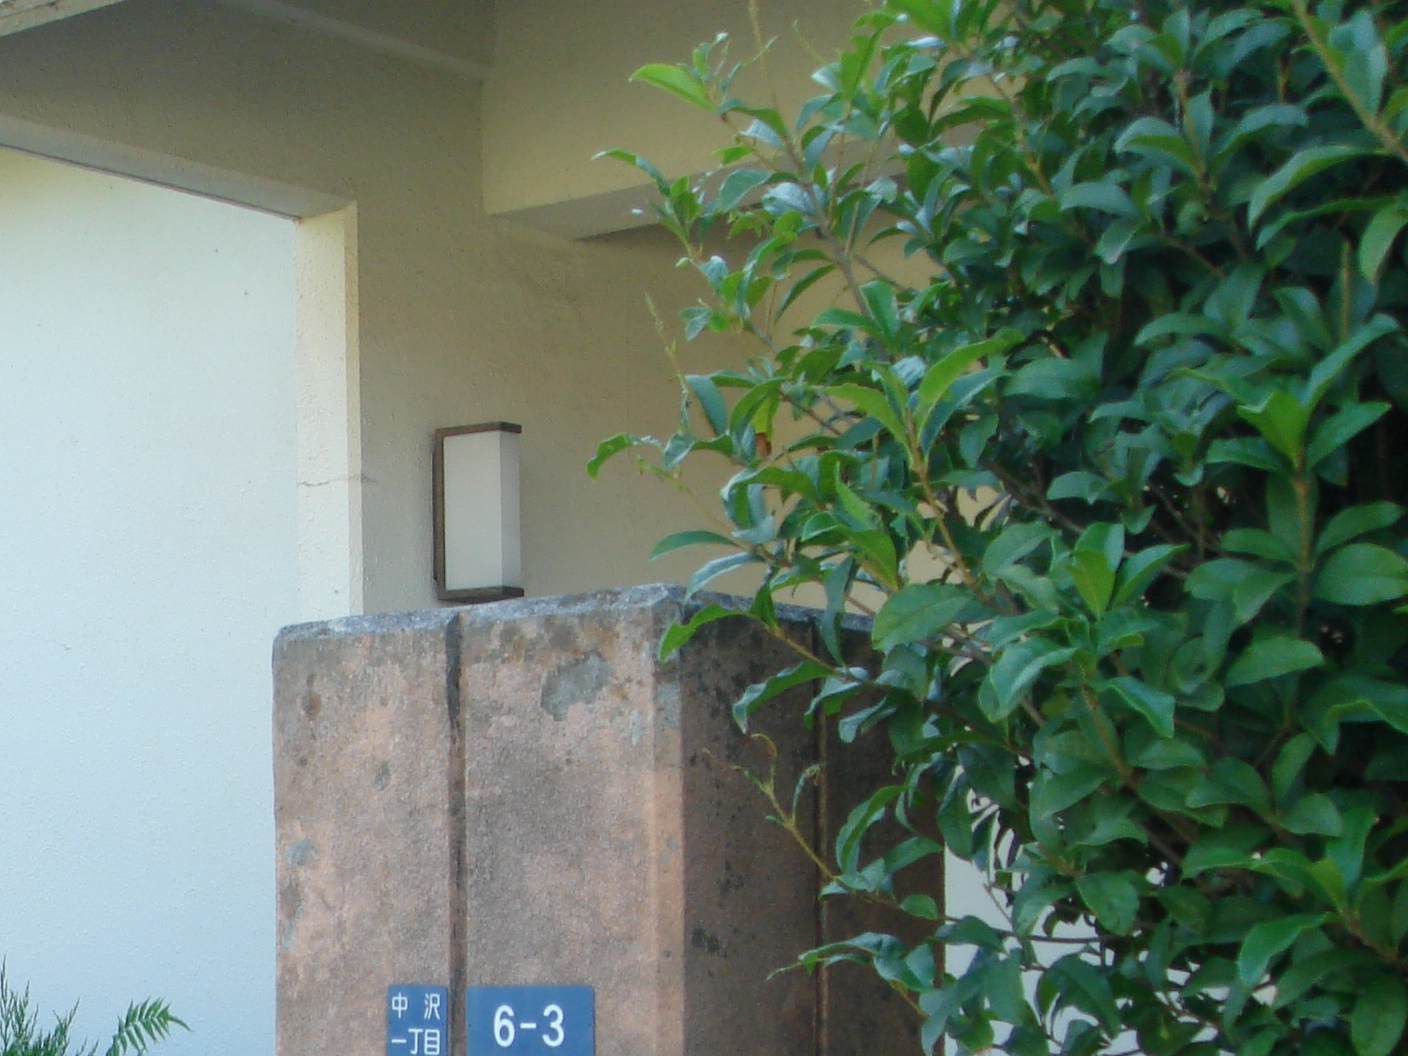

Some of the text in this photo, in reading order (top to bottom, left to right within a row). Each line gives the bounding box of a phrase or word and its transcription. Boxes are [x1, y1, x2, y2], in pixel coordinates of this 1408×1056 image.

[392, 992, 440, 1020] 中沢
[494, 1004, 565, 1047] 6-3
[391, 1028, 440, 1055] 一丁目
